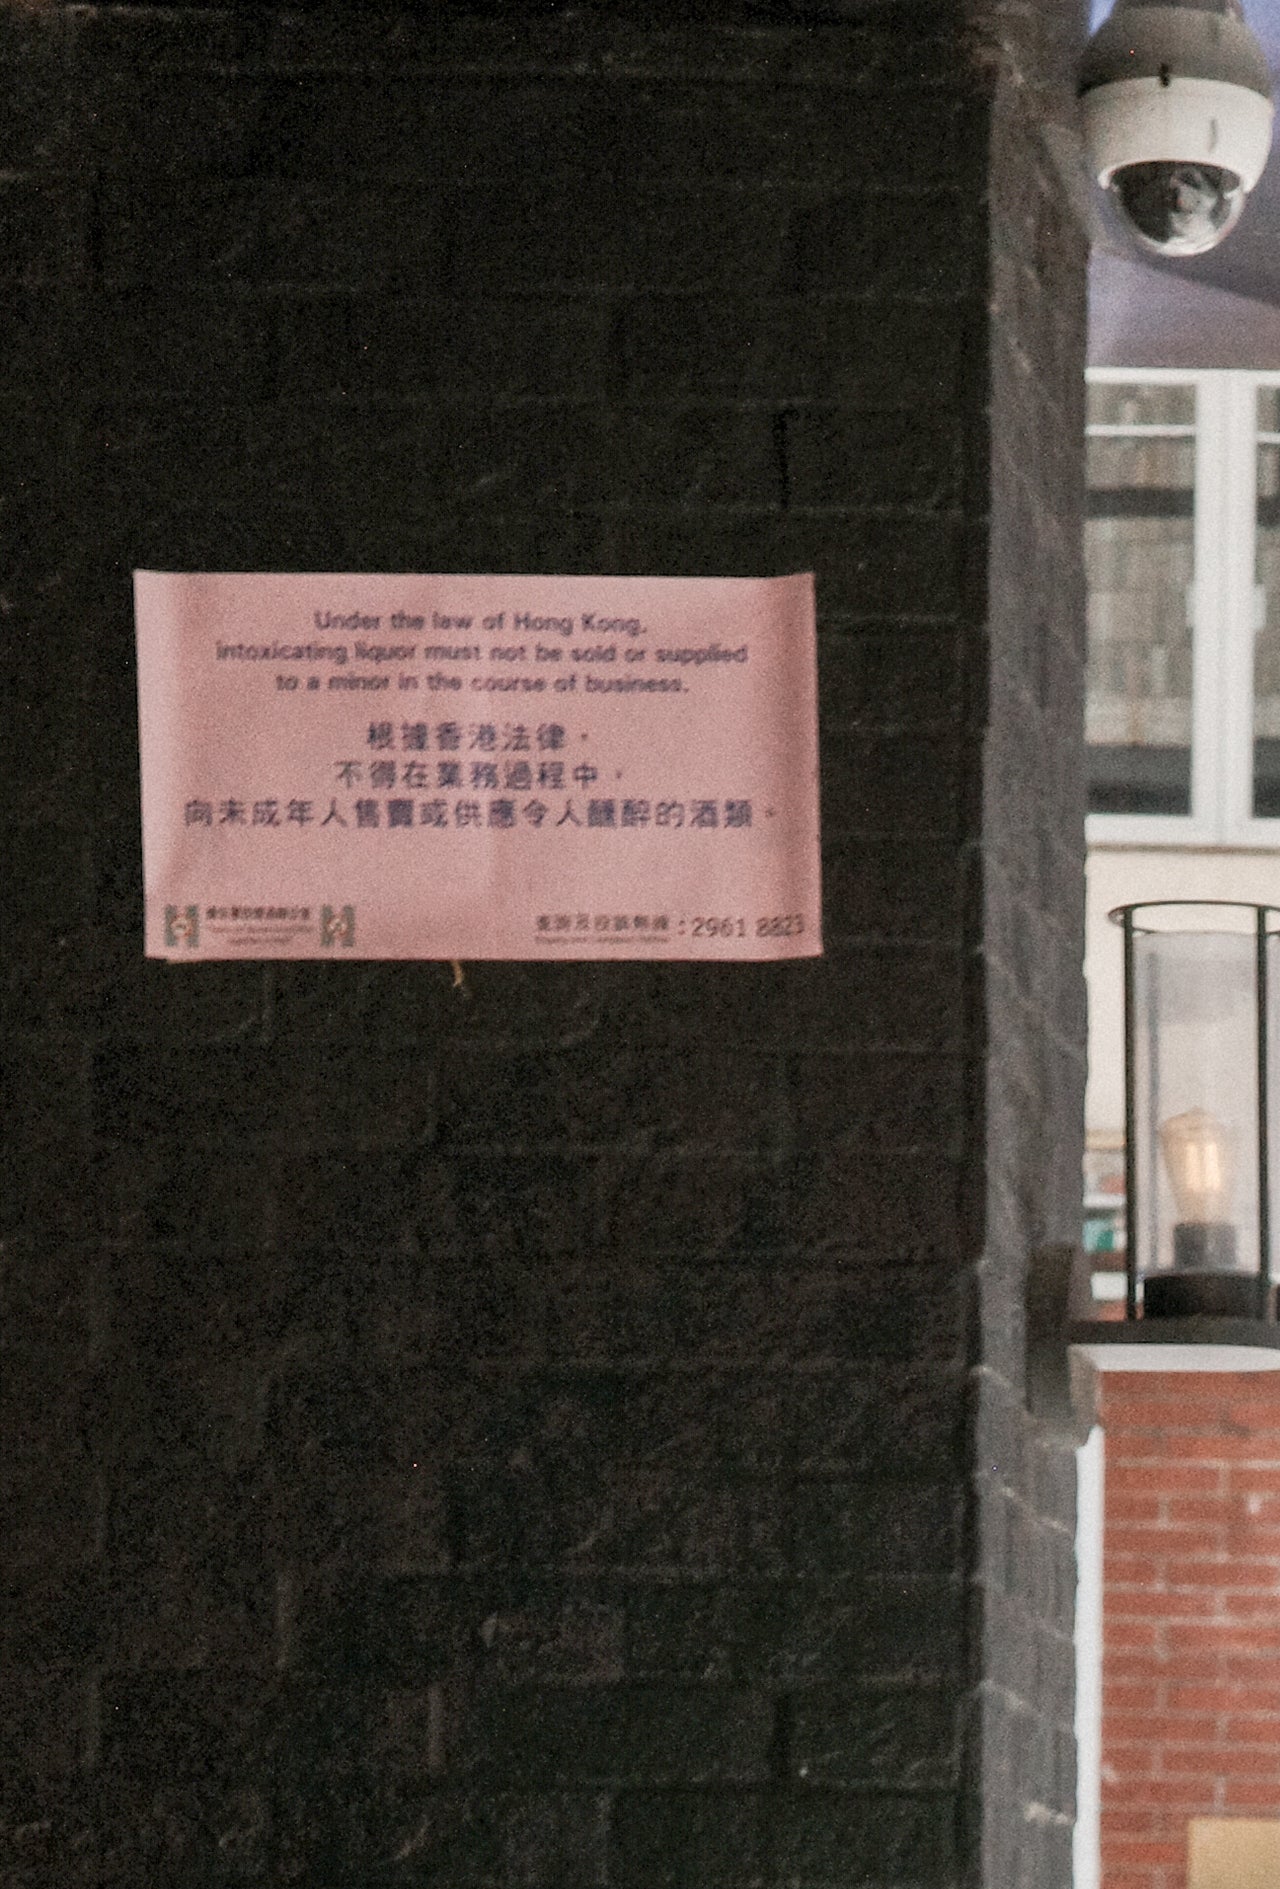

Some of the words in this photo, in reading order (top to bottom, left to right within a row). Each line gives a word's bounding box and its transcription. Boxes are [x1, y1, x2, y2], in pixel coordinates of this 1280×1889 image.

[314, 610, 380, 630] Under
[391, 609, 425, 630] the
[432, 611, 472, 630] law
[482, 612, 504, 631] of
[514, 613, 573, 636] Hong
[216, 641, 347, 664] intoxicating
[354, 641, 416, 664] liquor
[424, 645, 481, 661] must
[489, 645, 526, 662] not
[535, 642, 563, 662] be
[572, 643, 616, 663] sold
[624, 648, 646, 663] or
[655, 643, 748, 666] supplied
[276, 675, 298, 690] to
[307, 676, 320, 690] a
[329, 673, 389, 690] minor
[399, 672, 418, 690] in
[427, 672, 462, 691] the
[471, 676, 547, 692] course
[553, 674, 576, 692] of
[691, 917, 746, 938] 2961
